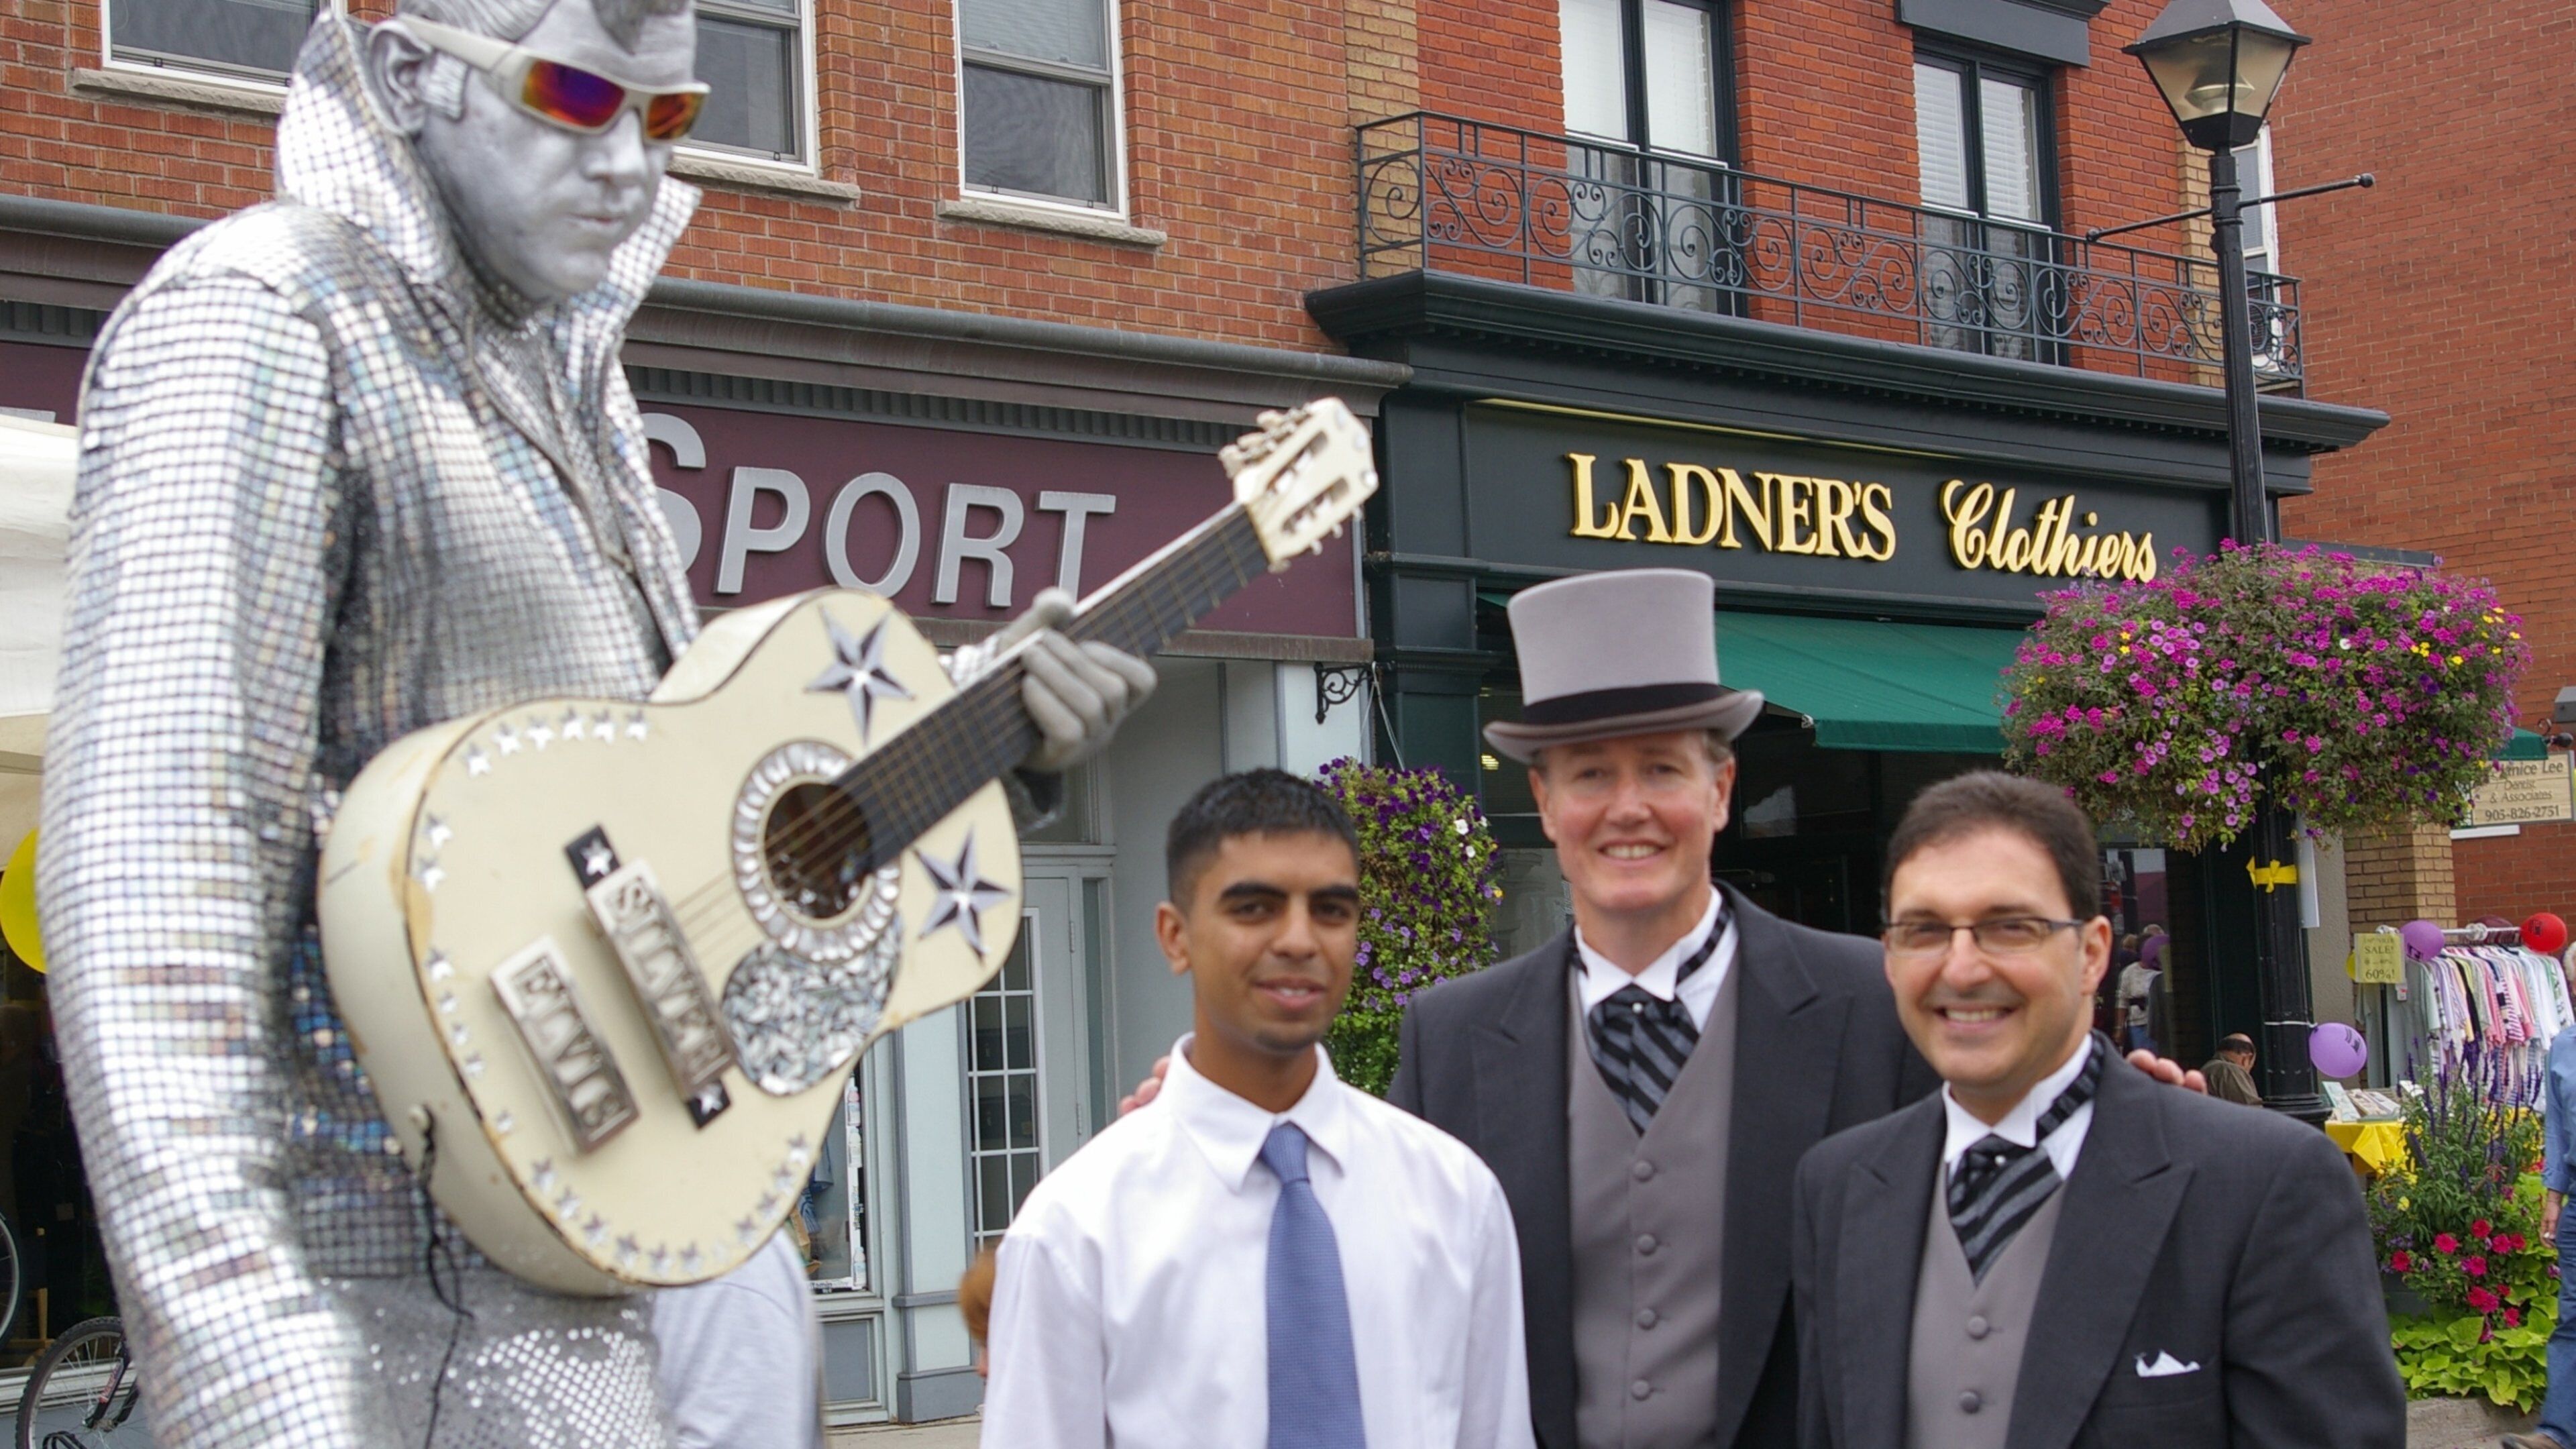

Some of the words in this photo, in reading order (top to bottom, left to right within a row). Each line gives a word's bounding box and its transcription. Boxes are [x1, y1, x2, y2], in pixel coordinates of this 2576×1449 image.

[639, 413, 1116, 612] SPORT
[1564, 452, 1896, 561] LADNER'S
[1940, 479, 2157, 583] Clothiers
[2489, 792, 2498, 804] &
[2542, 760, 2564, 773] Lee
[512, 955, 621, 1127] ELVIS
